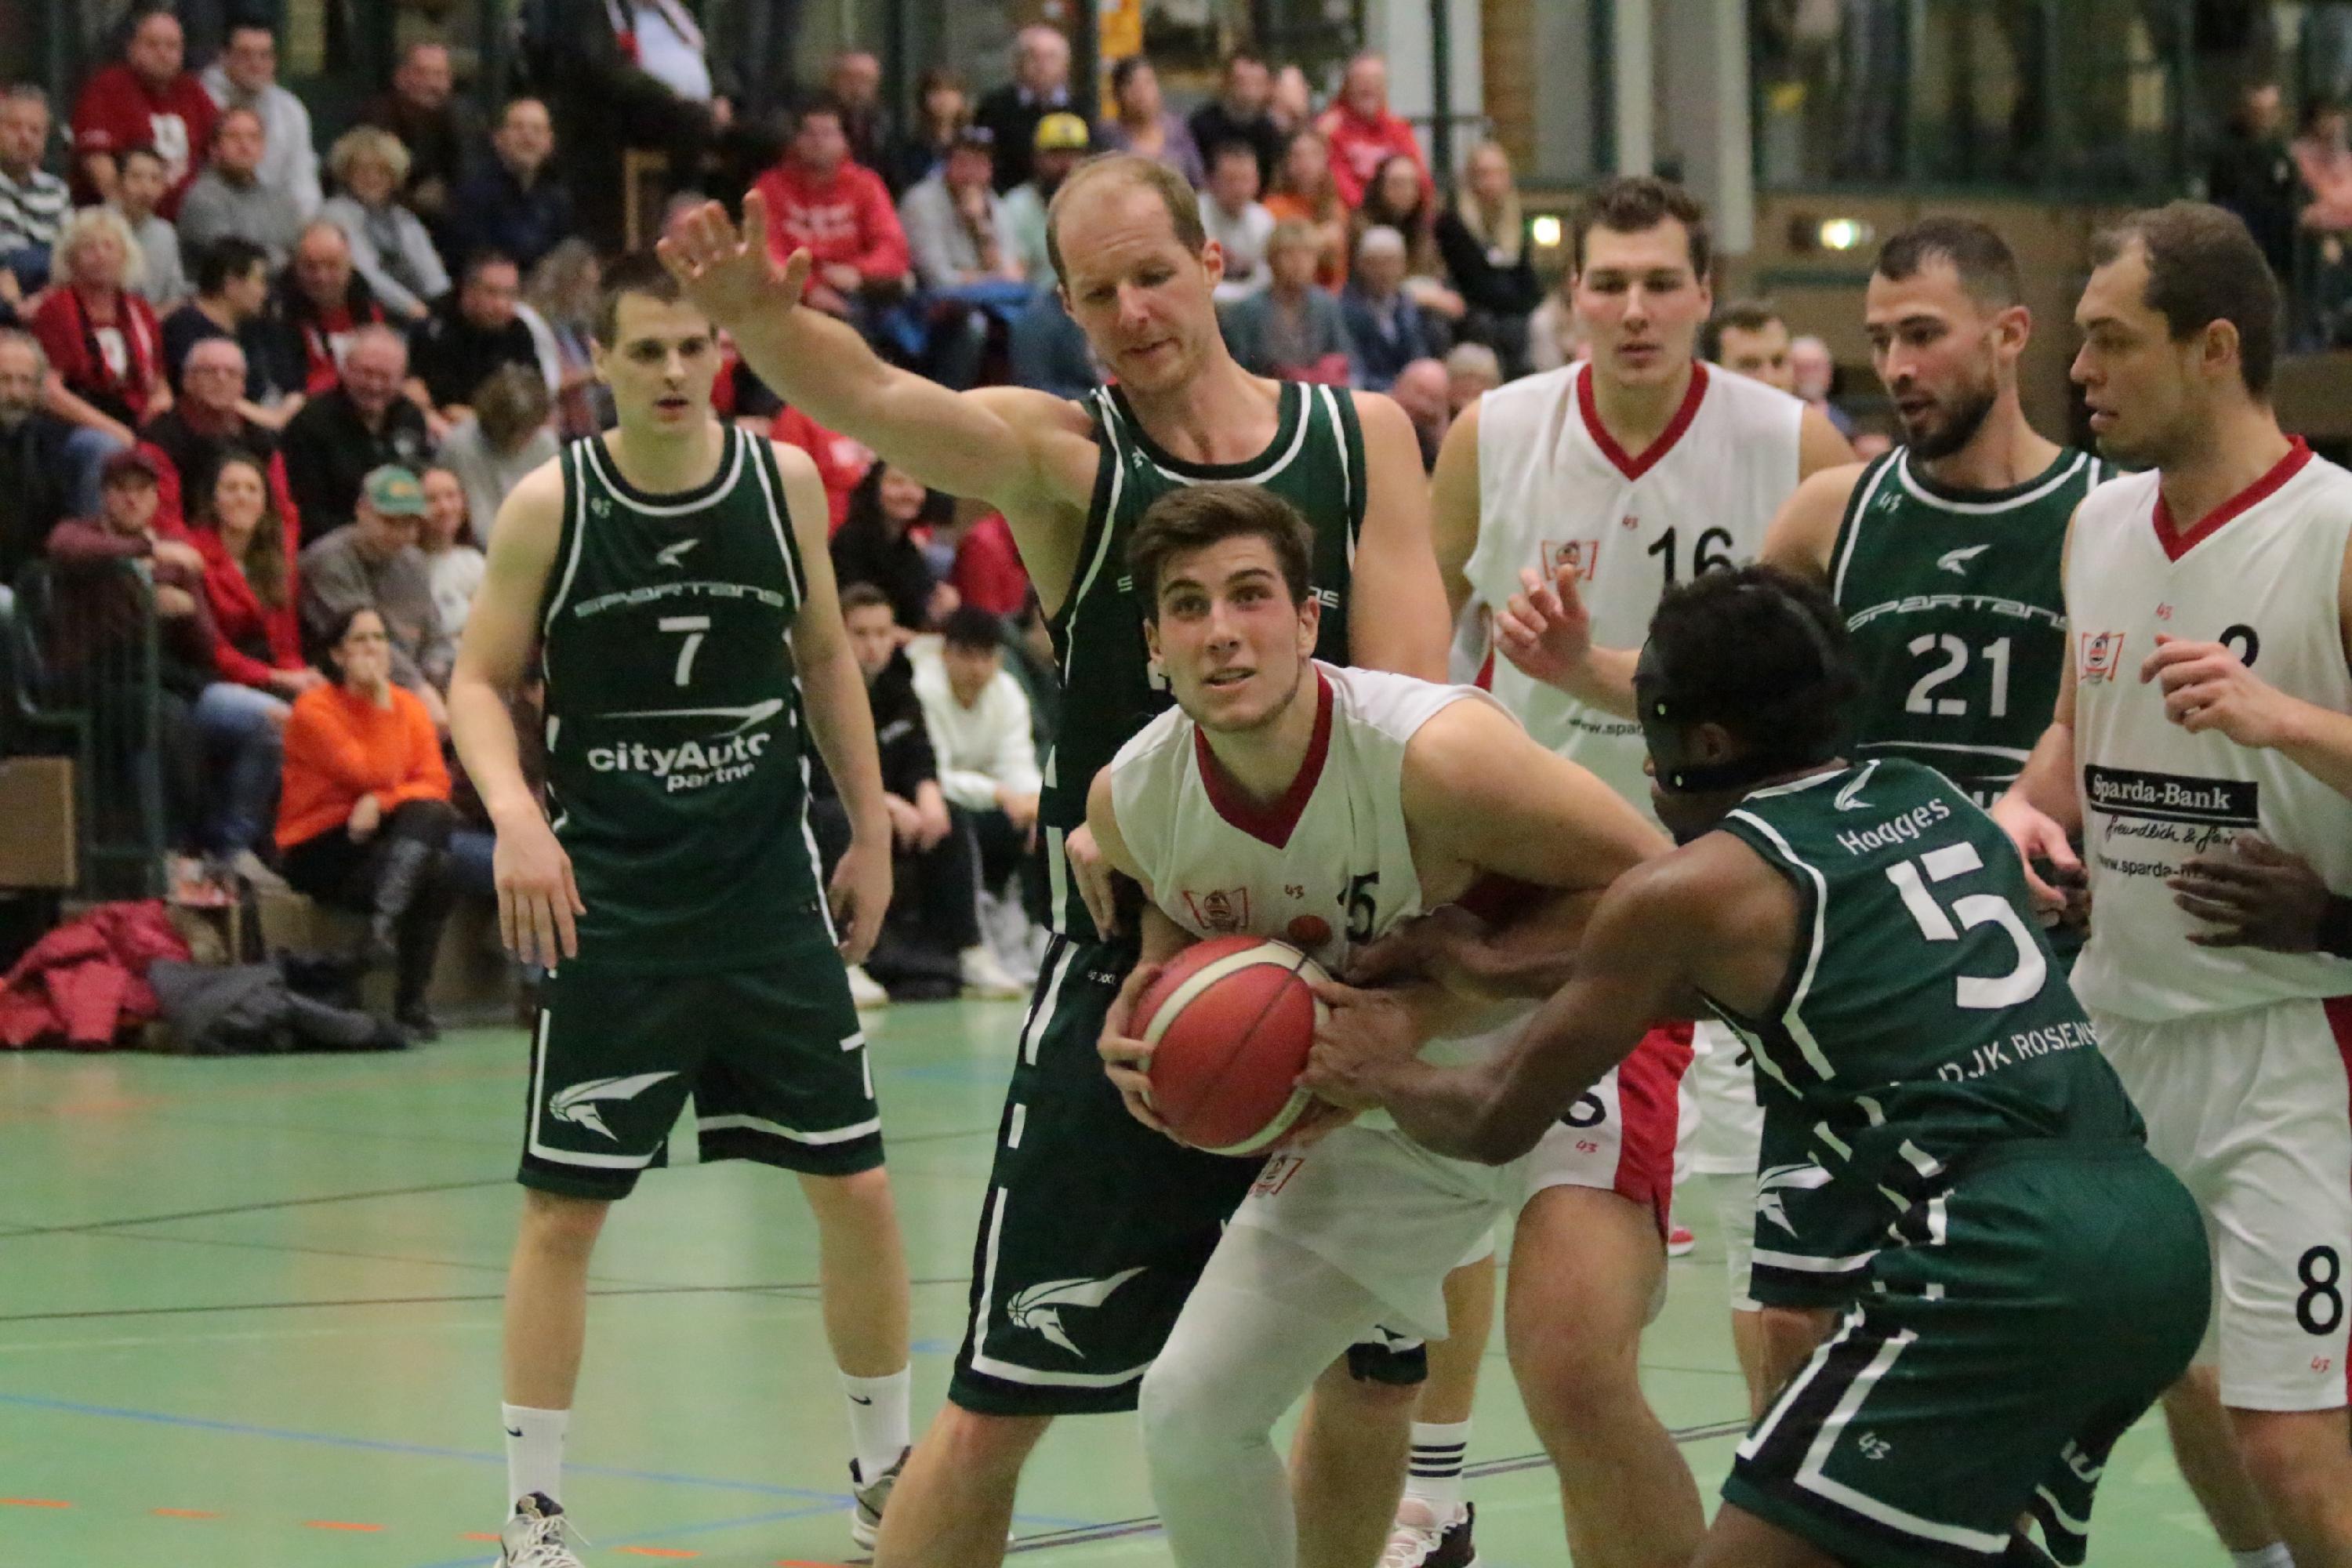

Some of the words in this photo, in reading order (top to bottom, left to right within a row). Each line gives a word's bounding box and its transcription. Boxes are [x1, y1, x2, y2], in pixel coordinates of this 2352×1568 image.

[659, 616, 710, 686] 7
[1906, 633, 2010, 717] 21
[2093, 774, 2232, 809] Sparda-Bank
[1886, 841, 2046, 1008] 15
[2296, 1245, 2343, 1336] 8
